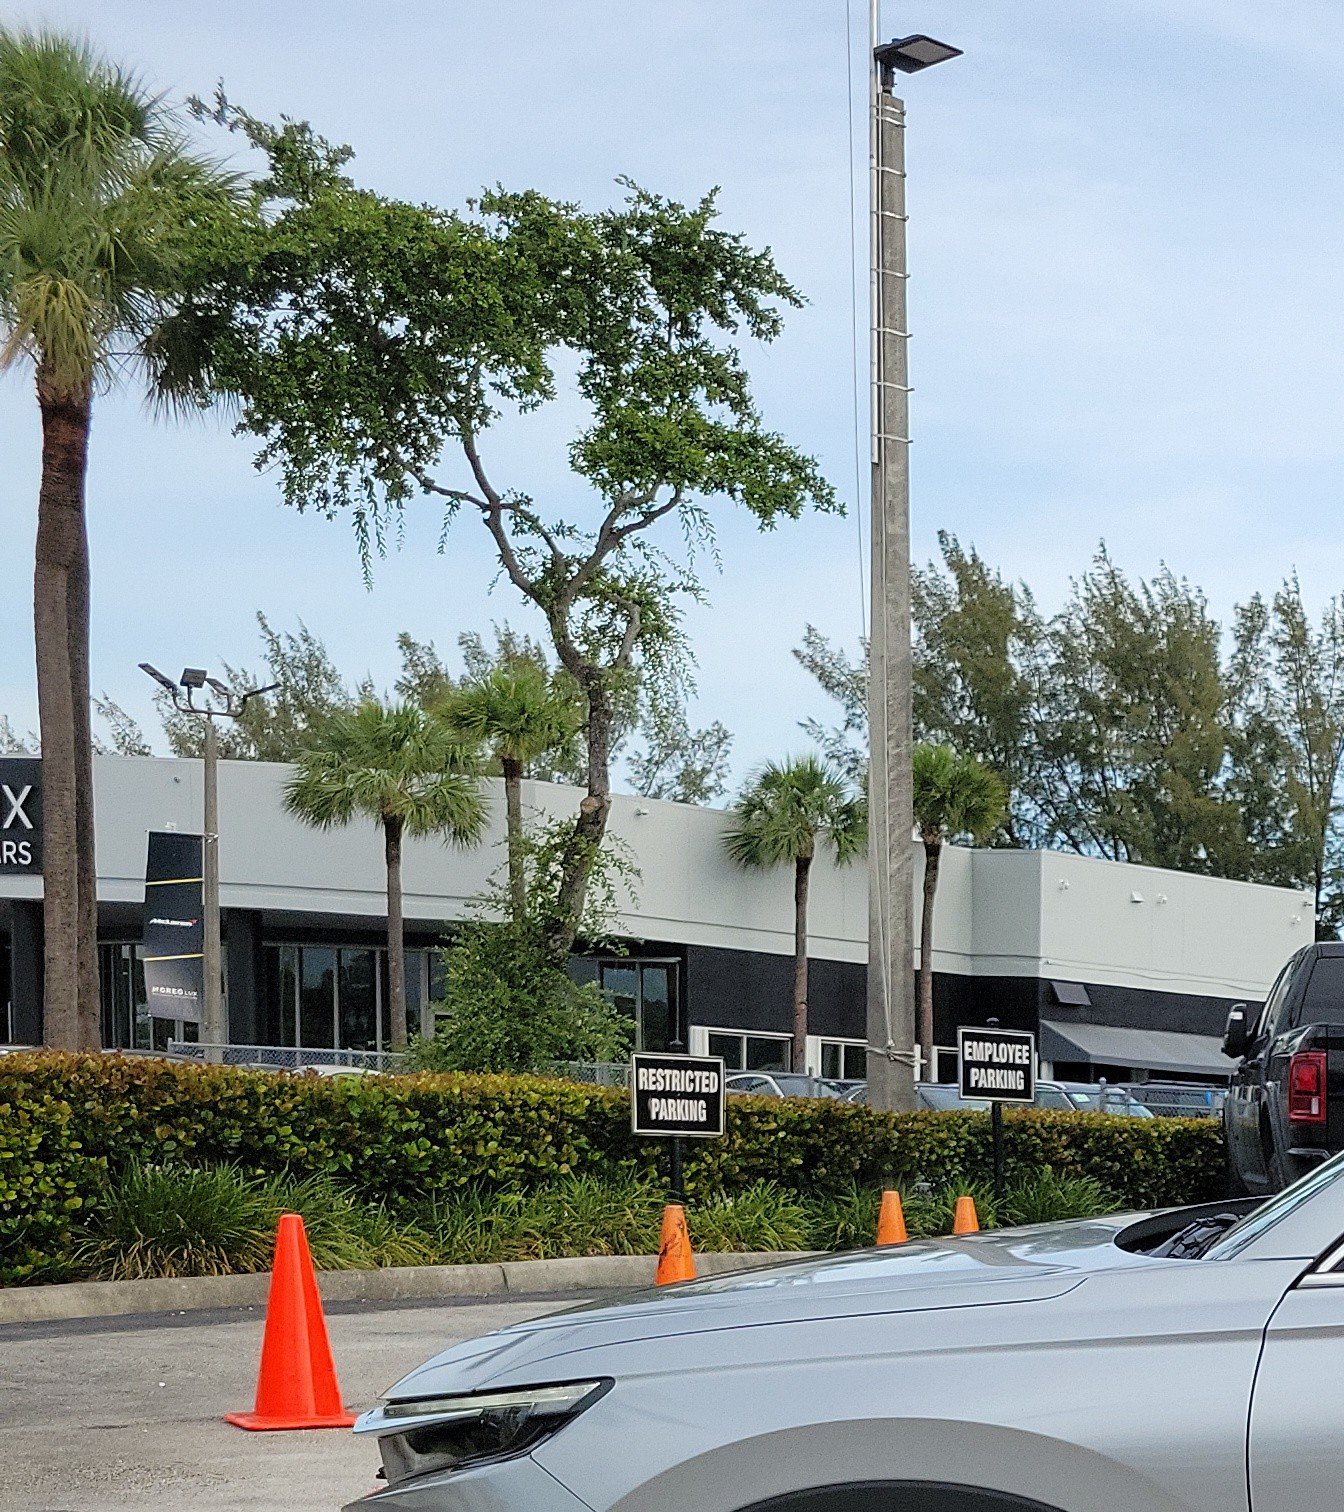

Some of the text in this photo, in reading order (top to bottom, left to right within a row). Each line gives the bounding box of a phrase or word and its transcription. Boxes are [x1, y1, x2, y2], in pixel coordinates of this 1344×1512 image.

[2, 785, 33, 829] X
[0, 840, 32, 865] RS
[964, 1040, 1030, 1065] EMPLOYEE
[638, 1067, 719, 1094] RESTRICTED
[970, 1067, 1025, 1090] PARKING
[650, 1097, 707, 1122] PARKING
